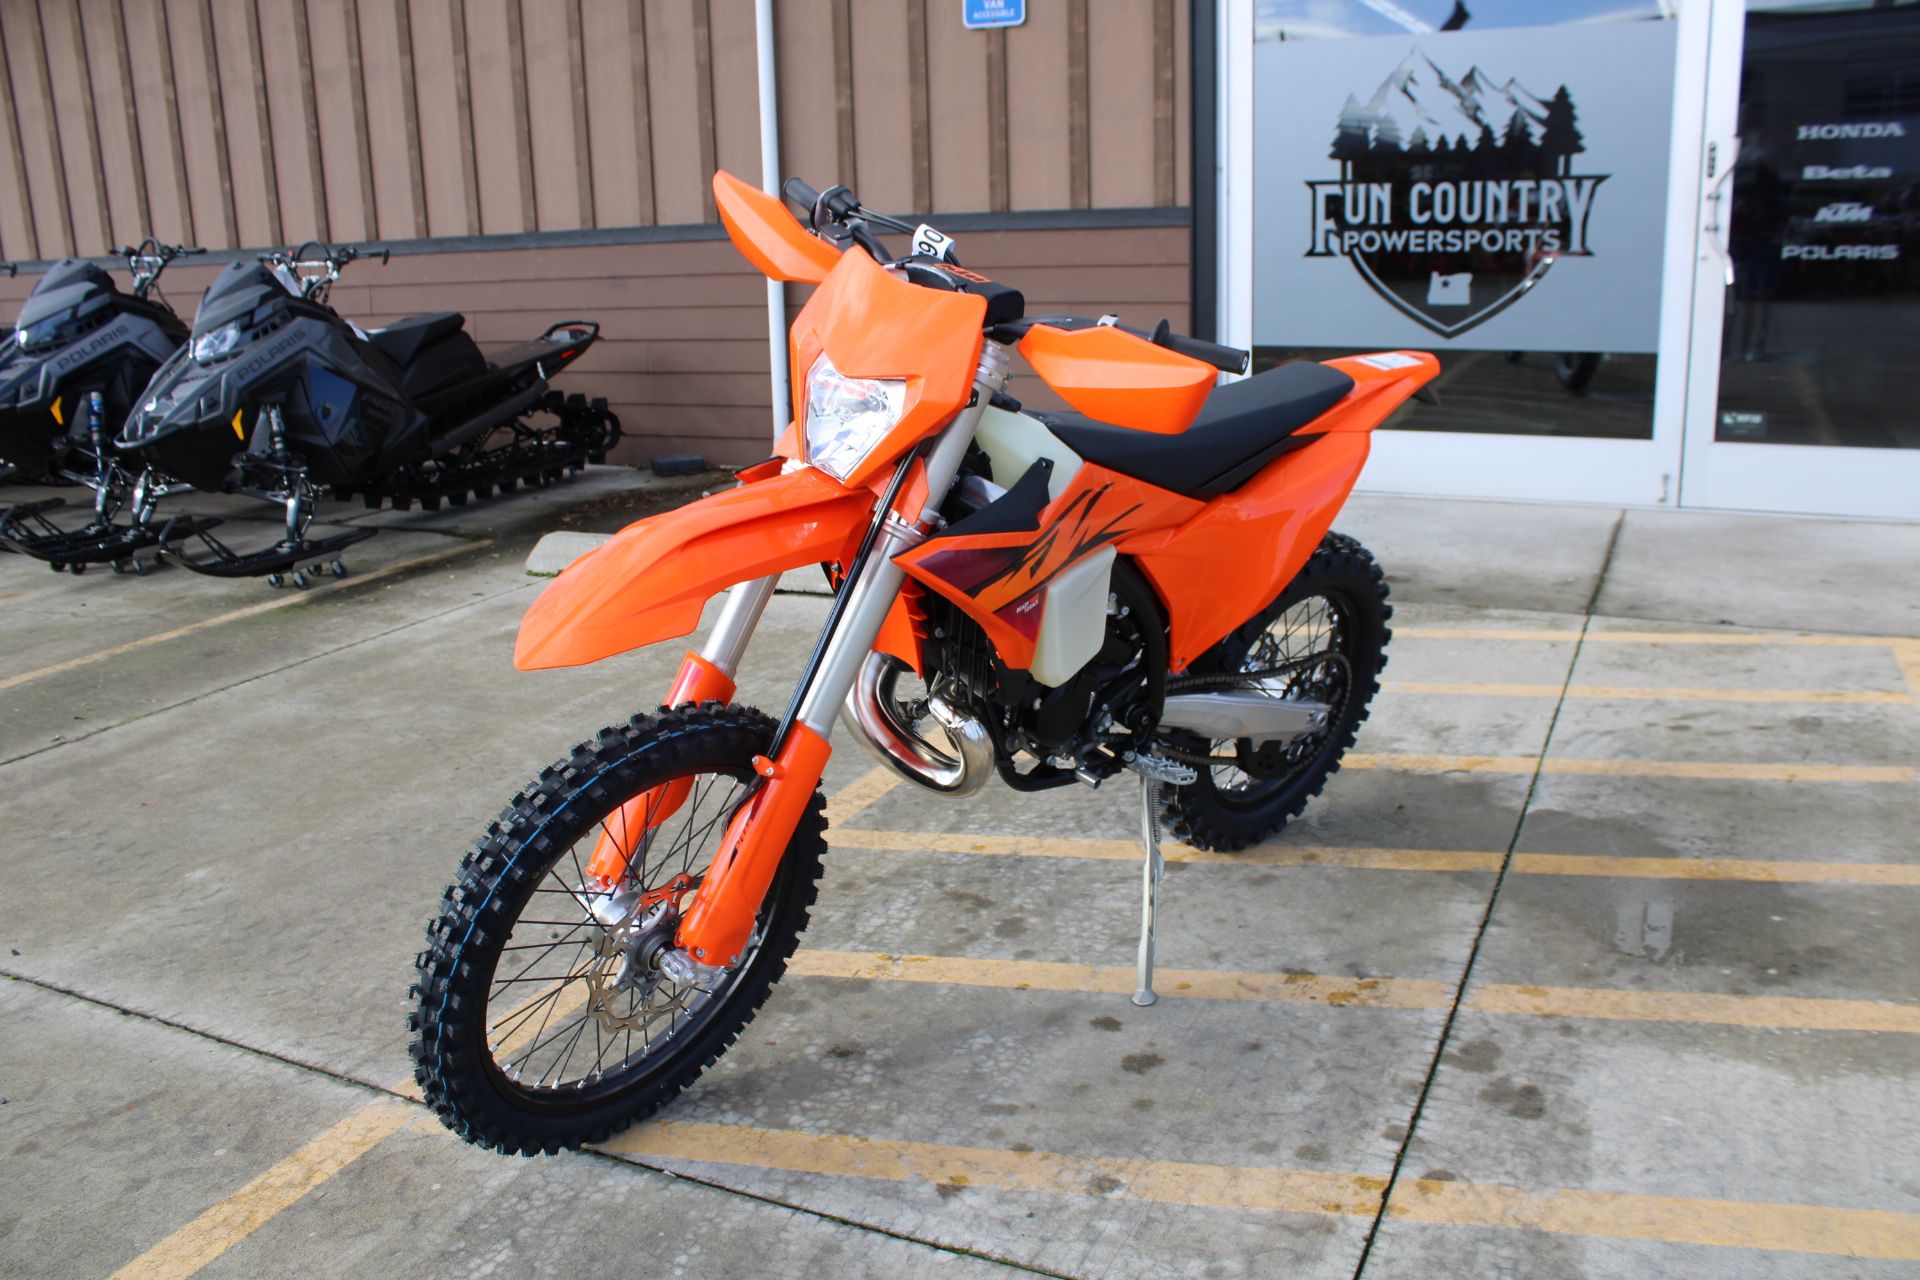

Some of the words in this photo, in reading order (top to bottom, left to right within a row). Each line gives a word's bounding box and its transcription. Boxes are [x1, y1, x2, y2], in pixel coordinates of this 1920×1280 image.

[1797, 122, 1905, 140] HONDA
[1802, 164, 1892, 180] Beta
[1310, 181, 1392, 255] FUN
[1410, 178, 1598, 254] COUNTRY
[1813, 202, 1873, 222] KTM
[1343, 229, 1561, 253] POWERSPORTS
[1781, 245, 1899, 260] POLARIS
[56, 324, 130, 371] POLARIS
[236, 329, 307, 381] POLARIS
